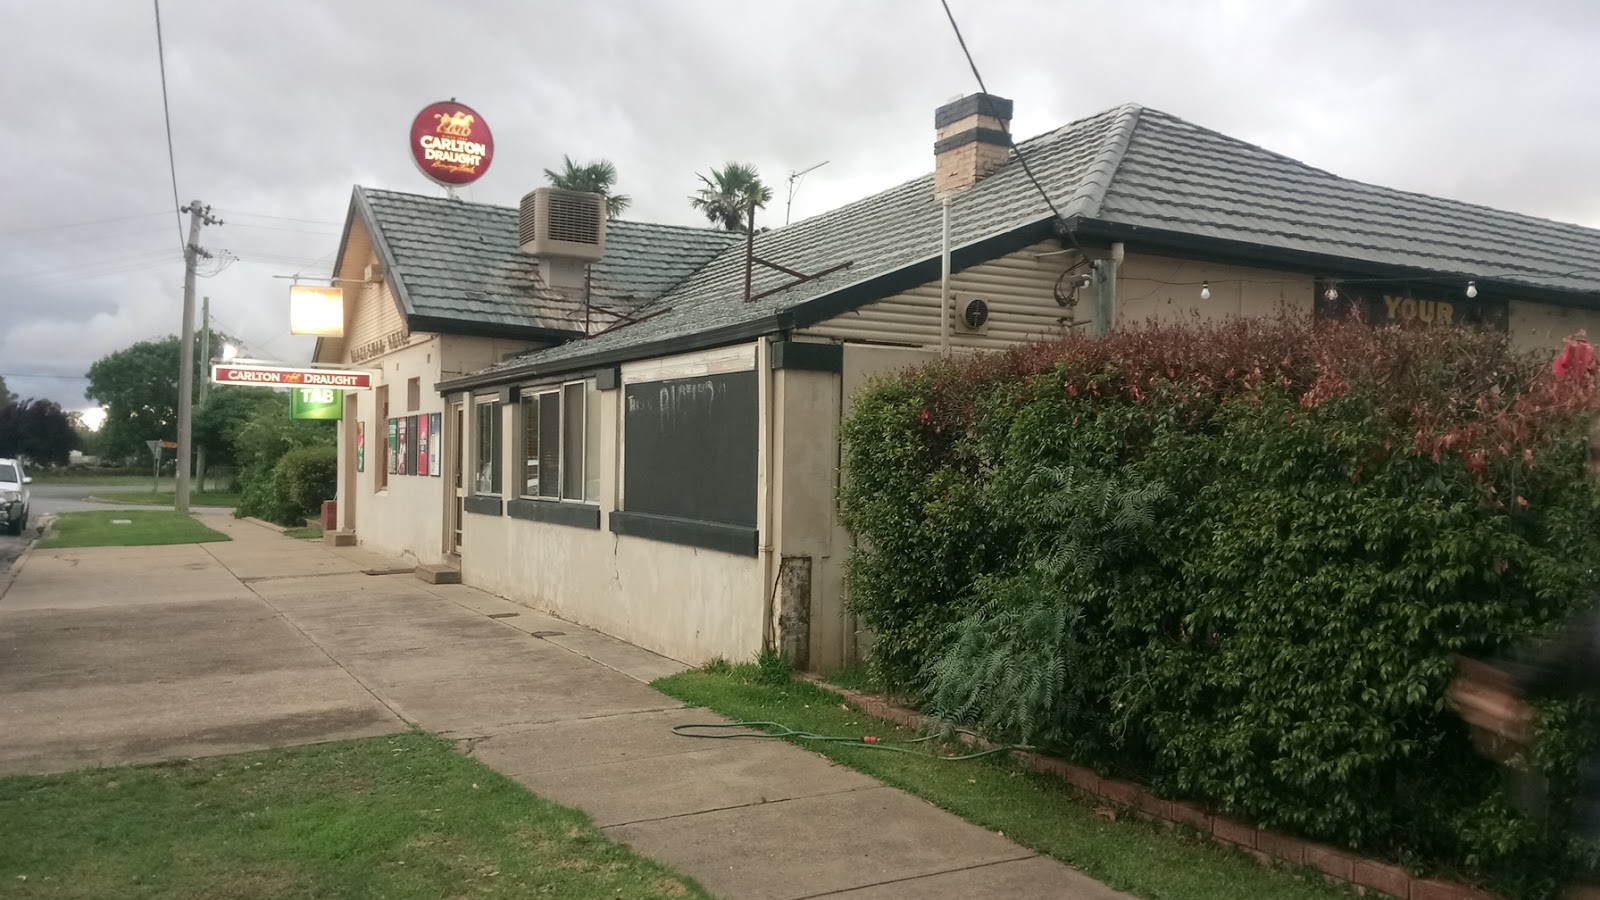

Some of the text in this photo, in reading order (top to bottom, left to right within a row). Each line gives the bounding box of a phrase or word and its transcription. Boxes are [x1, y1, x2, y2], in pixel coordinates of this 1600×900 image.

[420, 135, 486, 156] CARLTON
[425, 148, 481, 166] DRAUGHT
[1384, 294, 1454, 326] YOUR
[228, 370, 358, 386] CARLTON DRAUGHT
[300, 388, 334, 404] TAB
